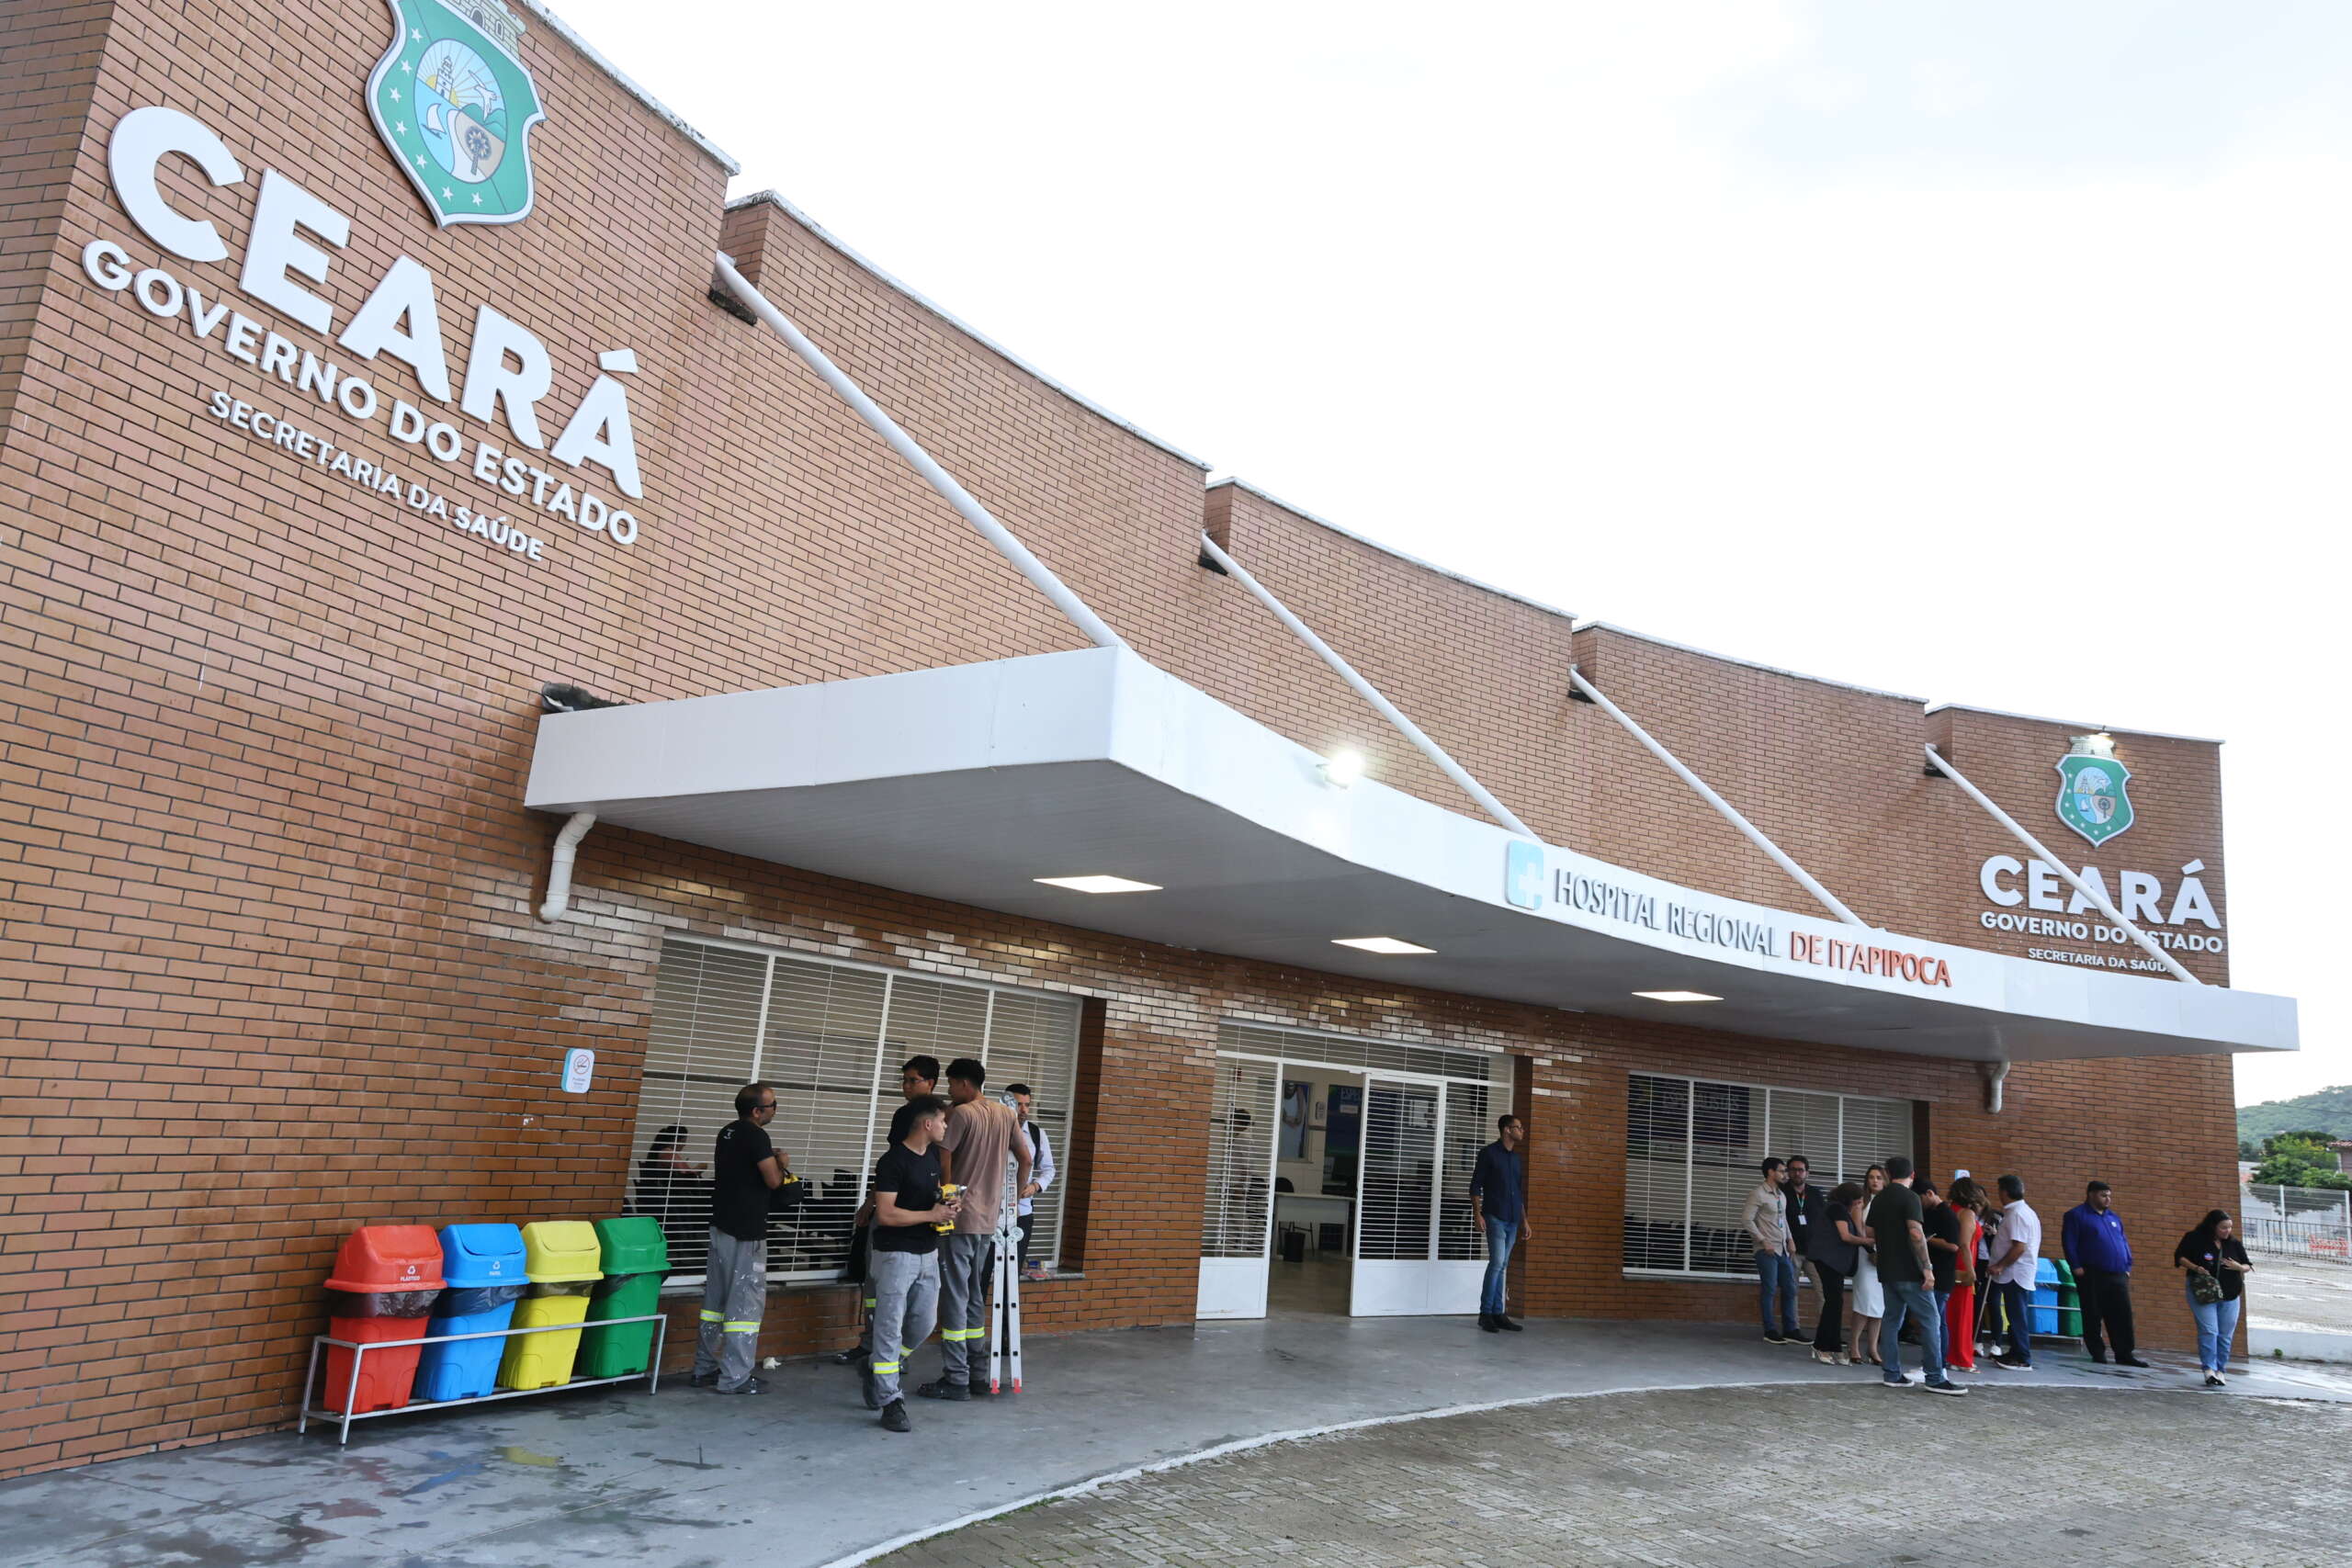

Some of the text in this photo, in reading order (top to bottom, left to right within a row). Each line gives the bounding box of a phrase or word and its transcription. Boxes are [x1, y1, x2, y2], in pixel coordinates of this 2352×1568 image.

[107, 106, 642, 499] CEARÁ
[82, 241, 639, 545] GOVERNO DO ESTADO
[207, 390, 544, 562] SECRETARIA DA SAÚDE
[1555, 868, 1952, 987] HOSPITAL REGIONAL DE ITAPIPOCA
[1980, 854, 2222, 930] CEARÁ
[1981, 911, 2223, 953] GOVERNO DO STADO
[2028, 947, 2172, 973] SECRETARIA DA SAÚD
